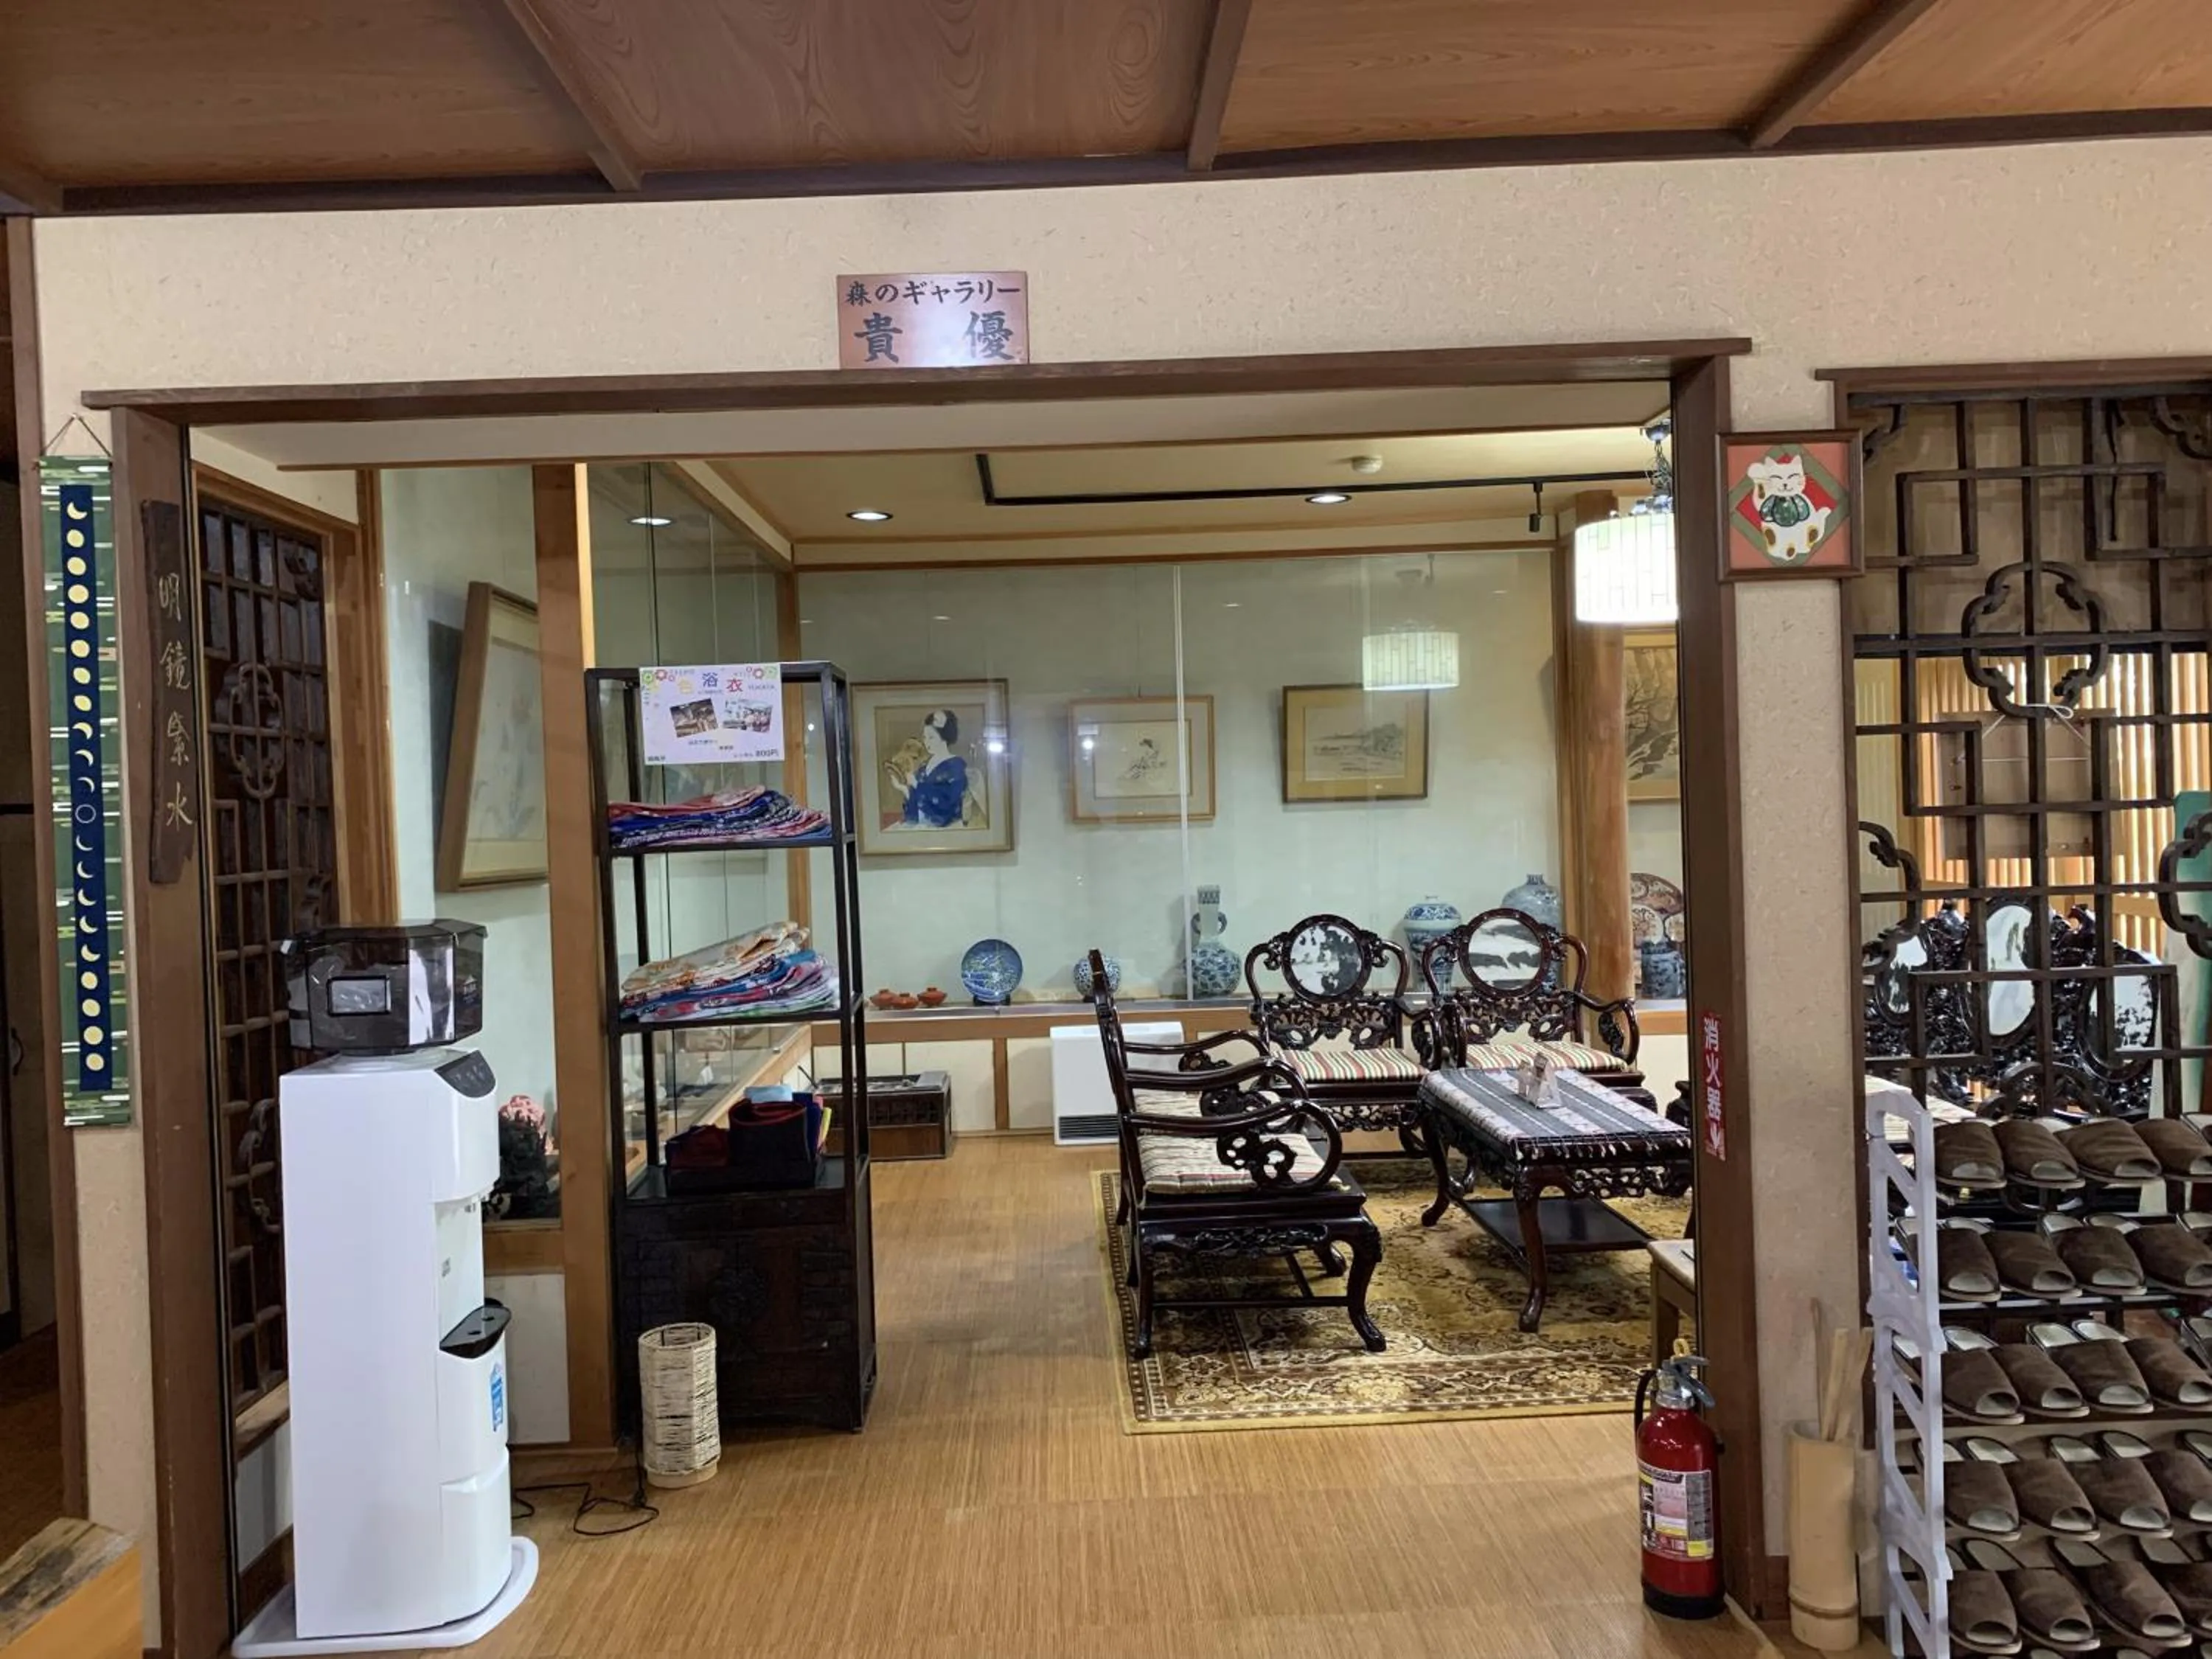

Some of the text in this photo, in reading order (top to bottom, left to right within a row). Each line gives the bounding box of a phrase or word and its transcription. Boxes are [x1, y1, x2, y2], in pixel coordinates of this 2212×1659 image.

[846, 279, 1020, 307] 森のギャラリー
[1704, 1016, 1722, 1121] 消火器
